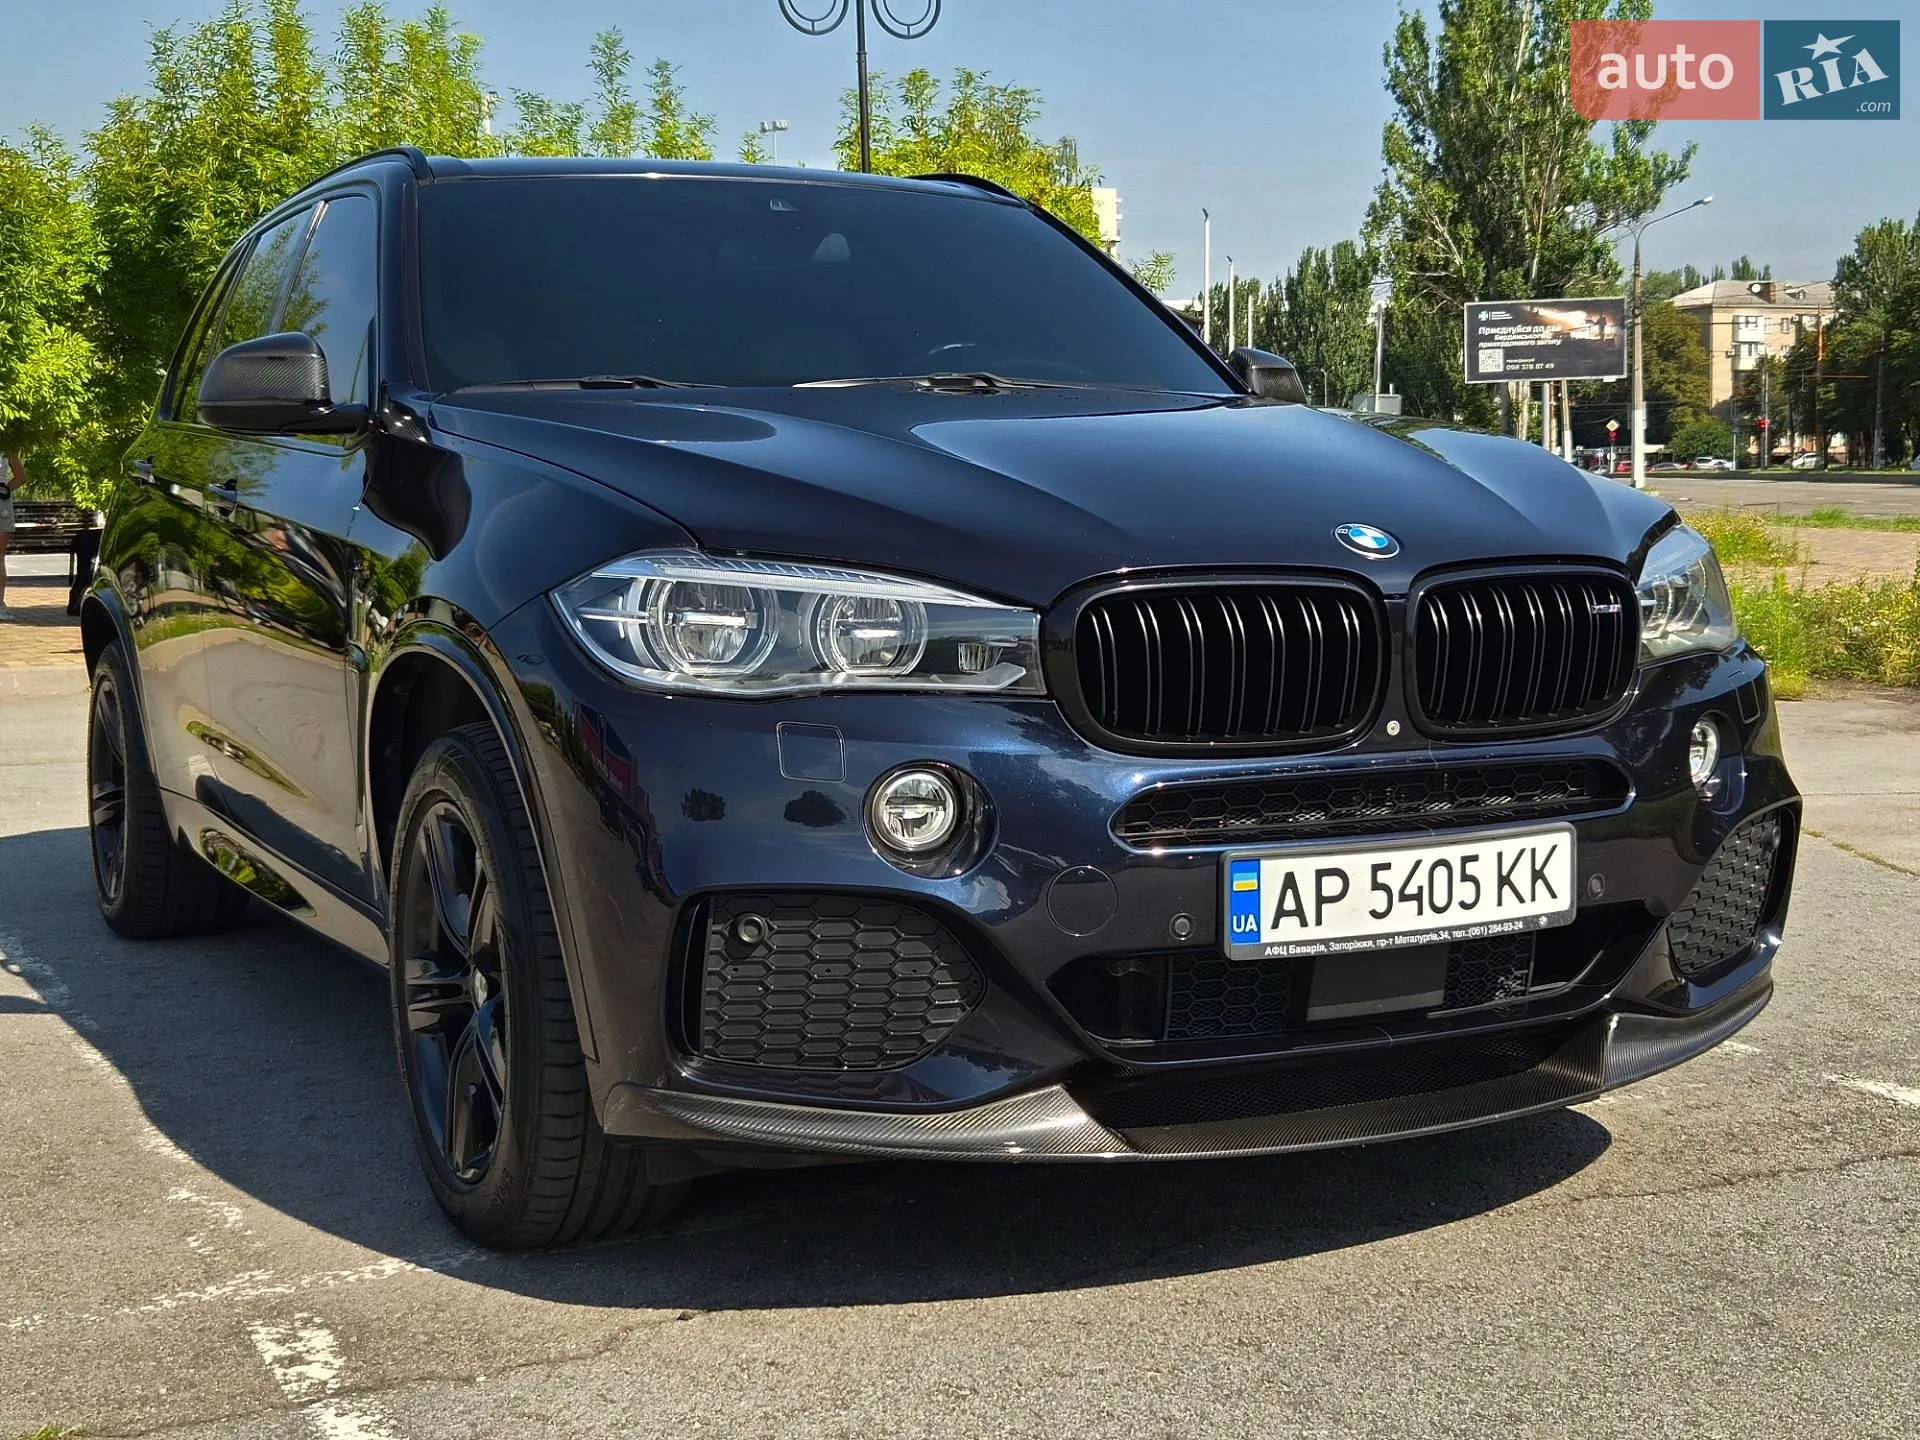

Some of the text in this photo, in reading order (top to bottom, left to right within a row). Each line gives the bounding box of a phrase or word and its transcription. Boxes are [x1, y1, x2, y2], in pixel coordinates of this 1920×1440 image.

[1533, 325, 1544, 334] до
[1270, 844, 1558, 930] AP 5405 KK
[1232, 914, 1258, 933] UA
[1264, 946, 1288, 956] АФЦ
[1288, 943, 1328, 955] Баварія,
[1488, 920, 1524, 934] 284-93-24
